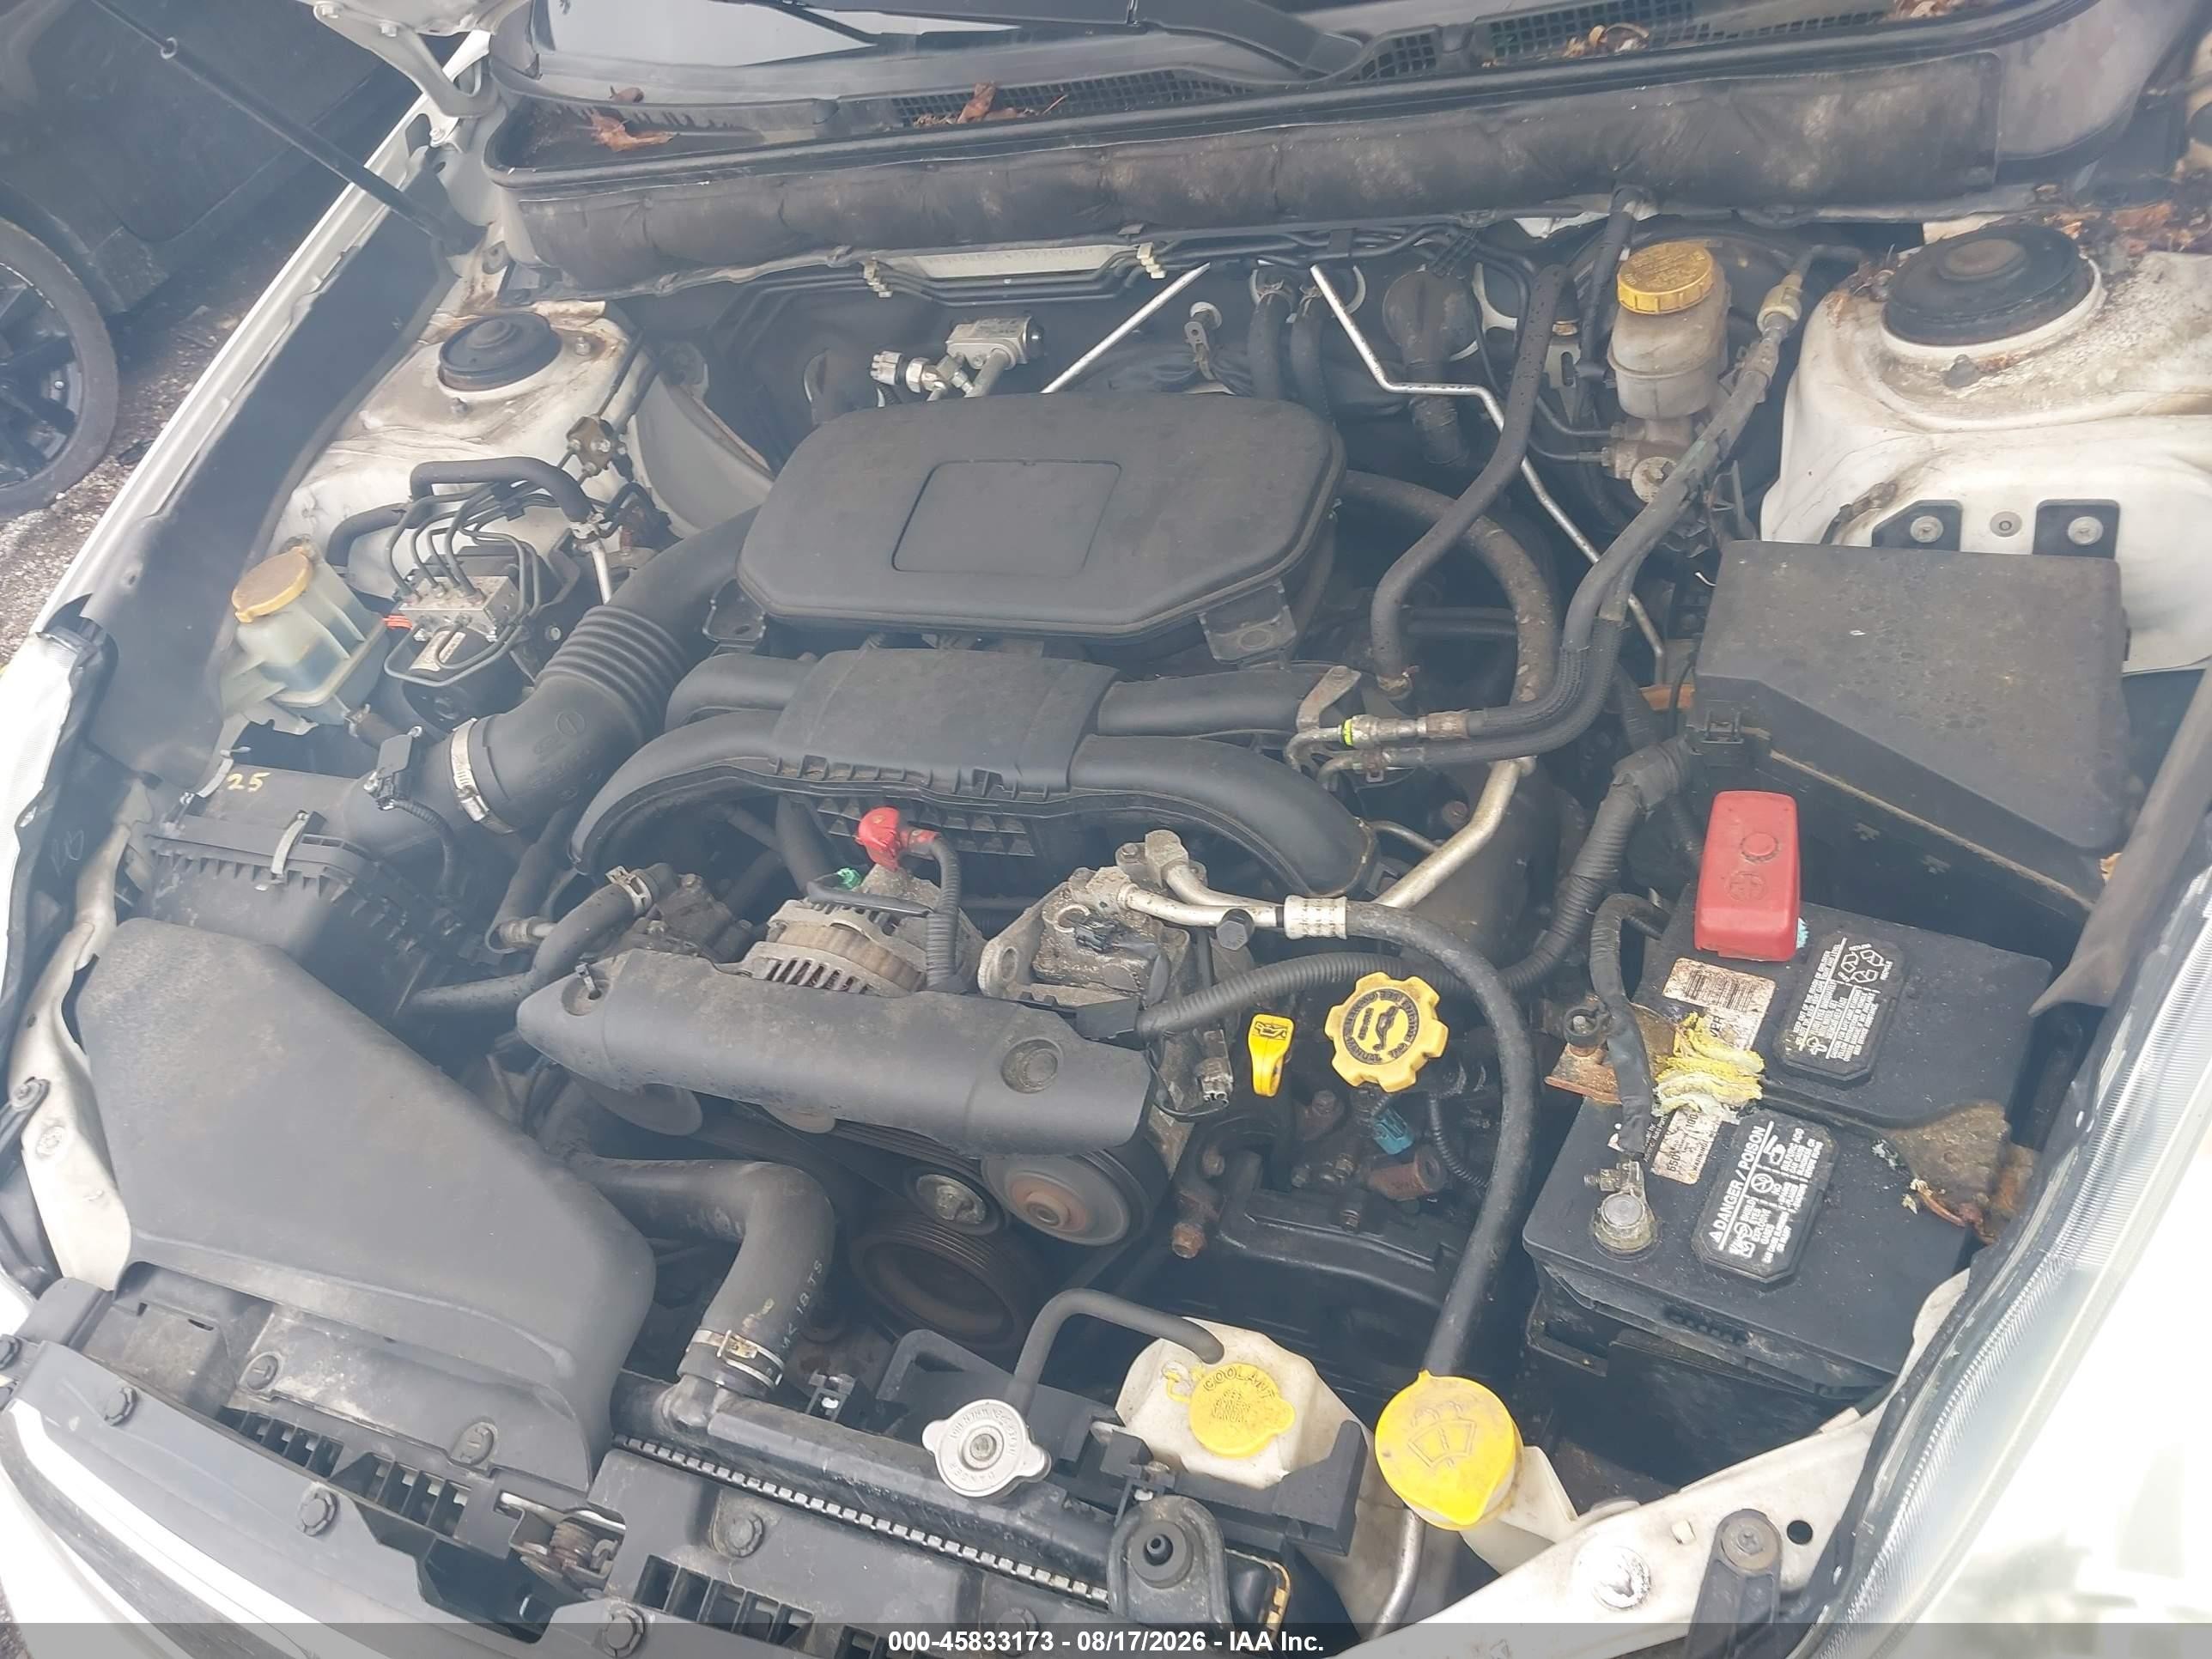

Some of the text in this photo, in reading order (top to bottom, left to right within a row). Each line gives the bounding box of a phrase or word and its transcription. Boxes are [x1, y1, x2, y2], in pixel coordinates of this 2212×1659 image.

[227, 772, 271, 793] 25
[1713, 1180, 1742, 1230] DANGER
[1738, 1126, 1765, 1170] POISON
[1771, 1183, 1782, 1195] NO
[1203, 1366, 1276, 1400] COOLANT
